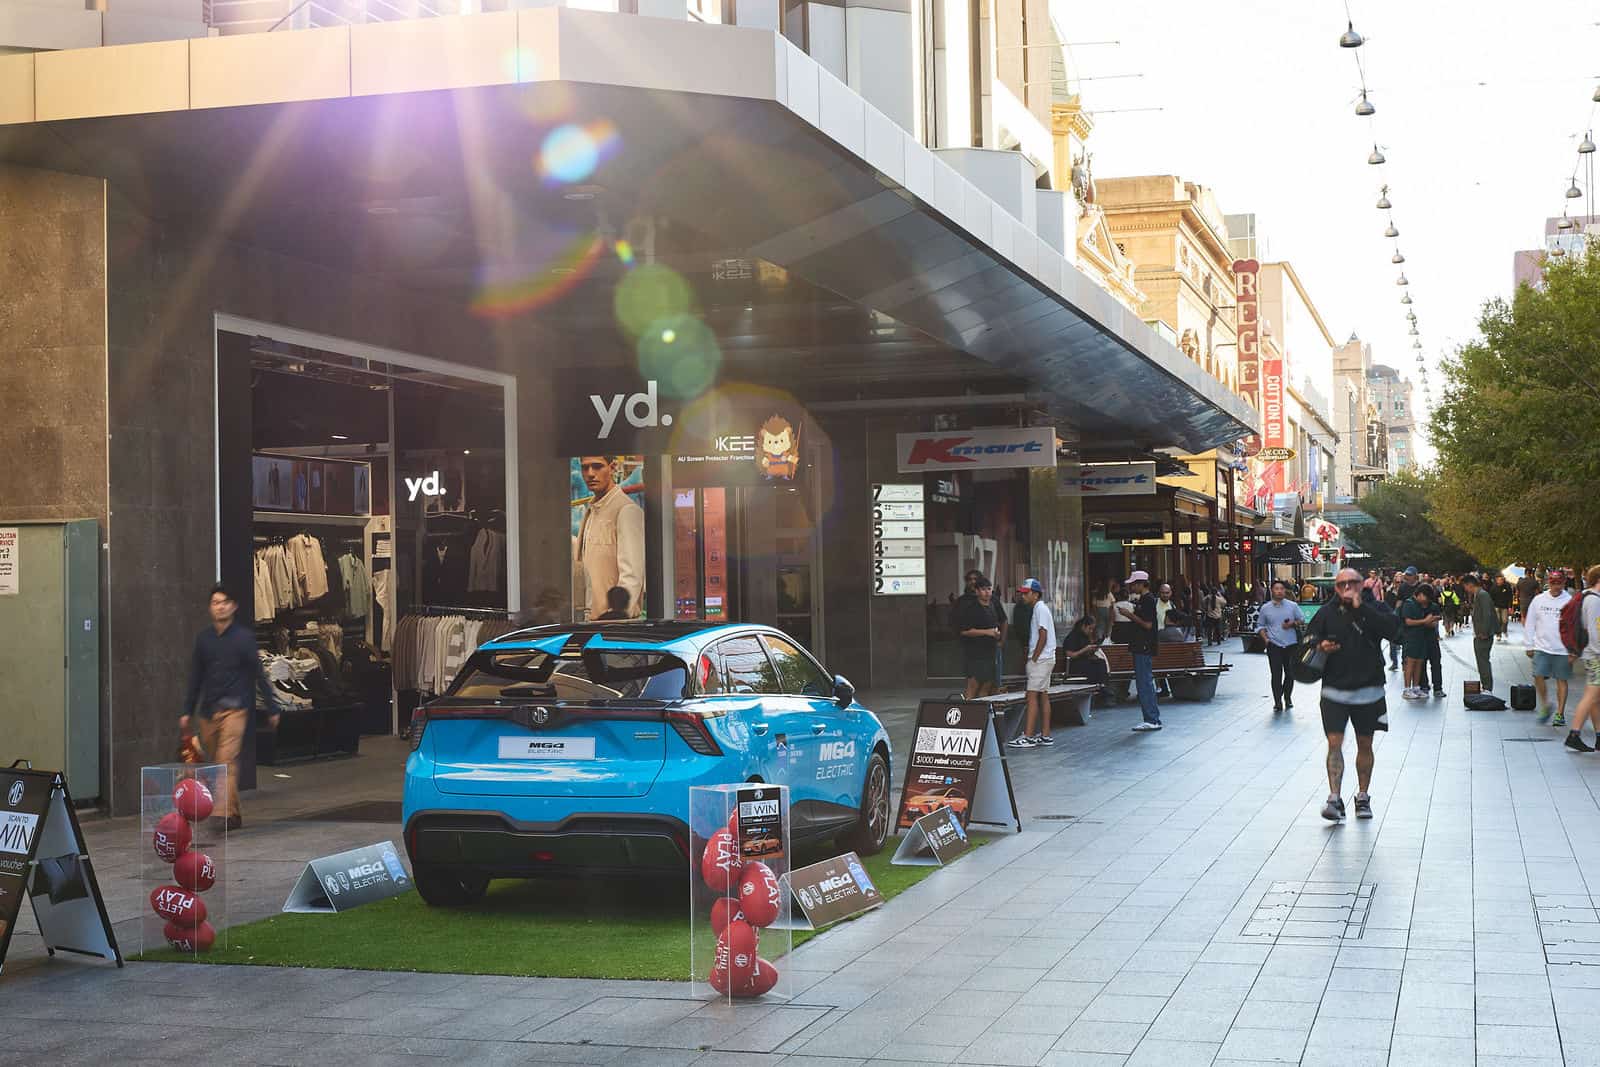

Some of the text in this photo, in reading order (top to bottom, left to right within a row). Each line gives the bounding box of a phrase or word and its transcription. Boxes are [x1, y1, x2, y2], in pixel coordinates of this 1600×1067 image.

[1237, 271, 1260, 443] REGEN
[589, 380, 673, 439] yd.
[1269, 375, 1281, 439] COTTON ON
[715, 436, 755, 452] KEE
[907, 437, 1043, 465] Kmart
[404, 470, 447, 502] yd.
[872, 485, 882, 501] 7
[873, 503, 883, 520] 6
[874, 521, 884, 538] 5
[874, 541, 884, 557] 4
[875, 560, 884, 576] 3
[876, 578, 885, 594] 2
[819, 740, 855, 762] MG4
[941, 735, 979, 754] WIN
[815, 763, 855, 780] ELECTRIC
[753, 804, 777, 815] WIN
[715, 833, 732, 871] PLAY
[347, 860, 385, 880] MG4
[352, 872, 390, 890] ELECTRIC
[758, 861, 781, 909] PLAY
[819, 872, 853, 893] MG4
[156, 889, 195, 909] PLAY
[825, 884, 859, 904] ELECTRIC
